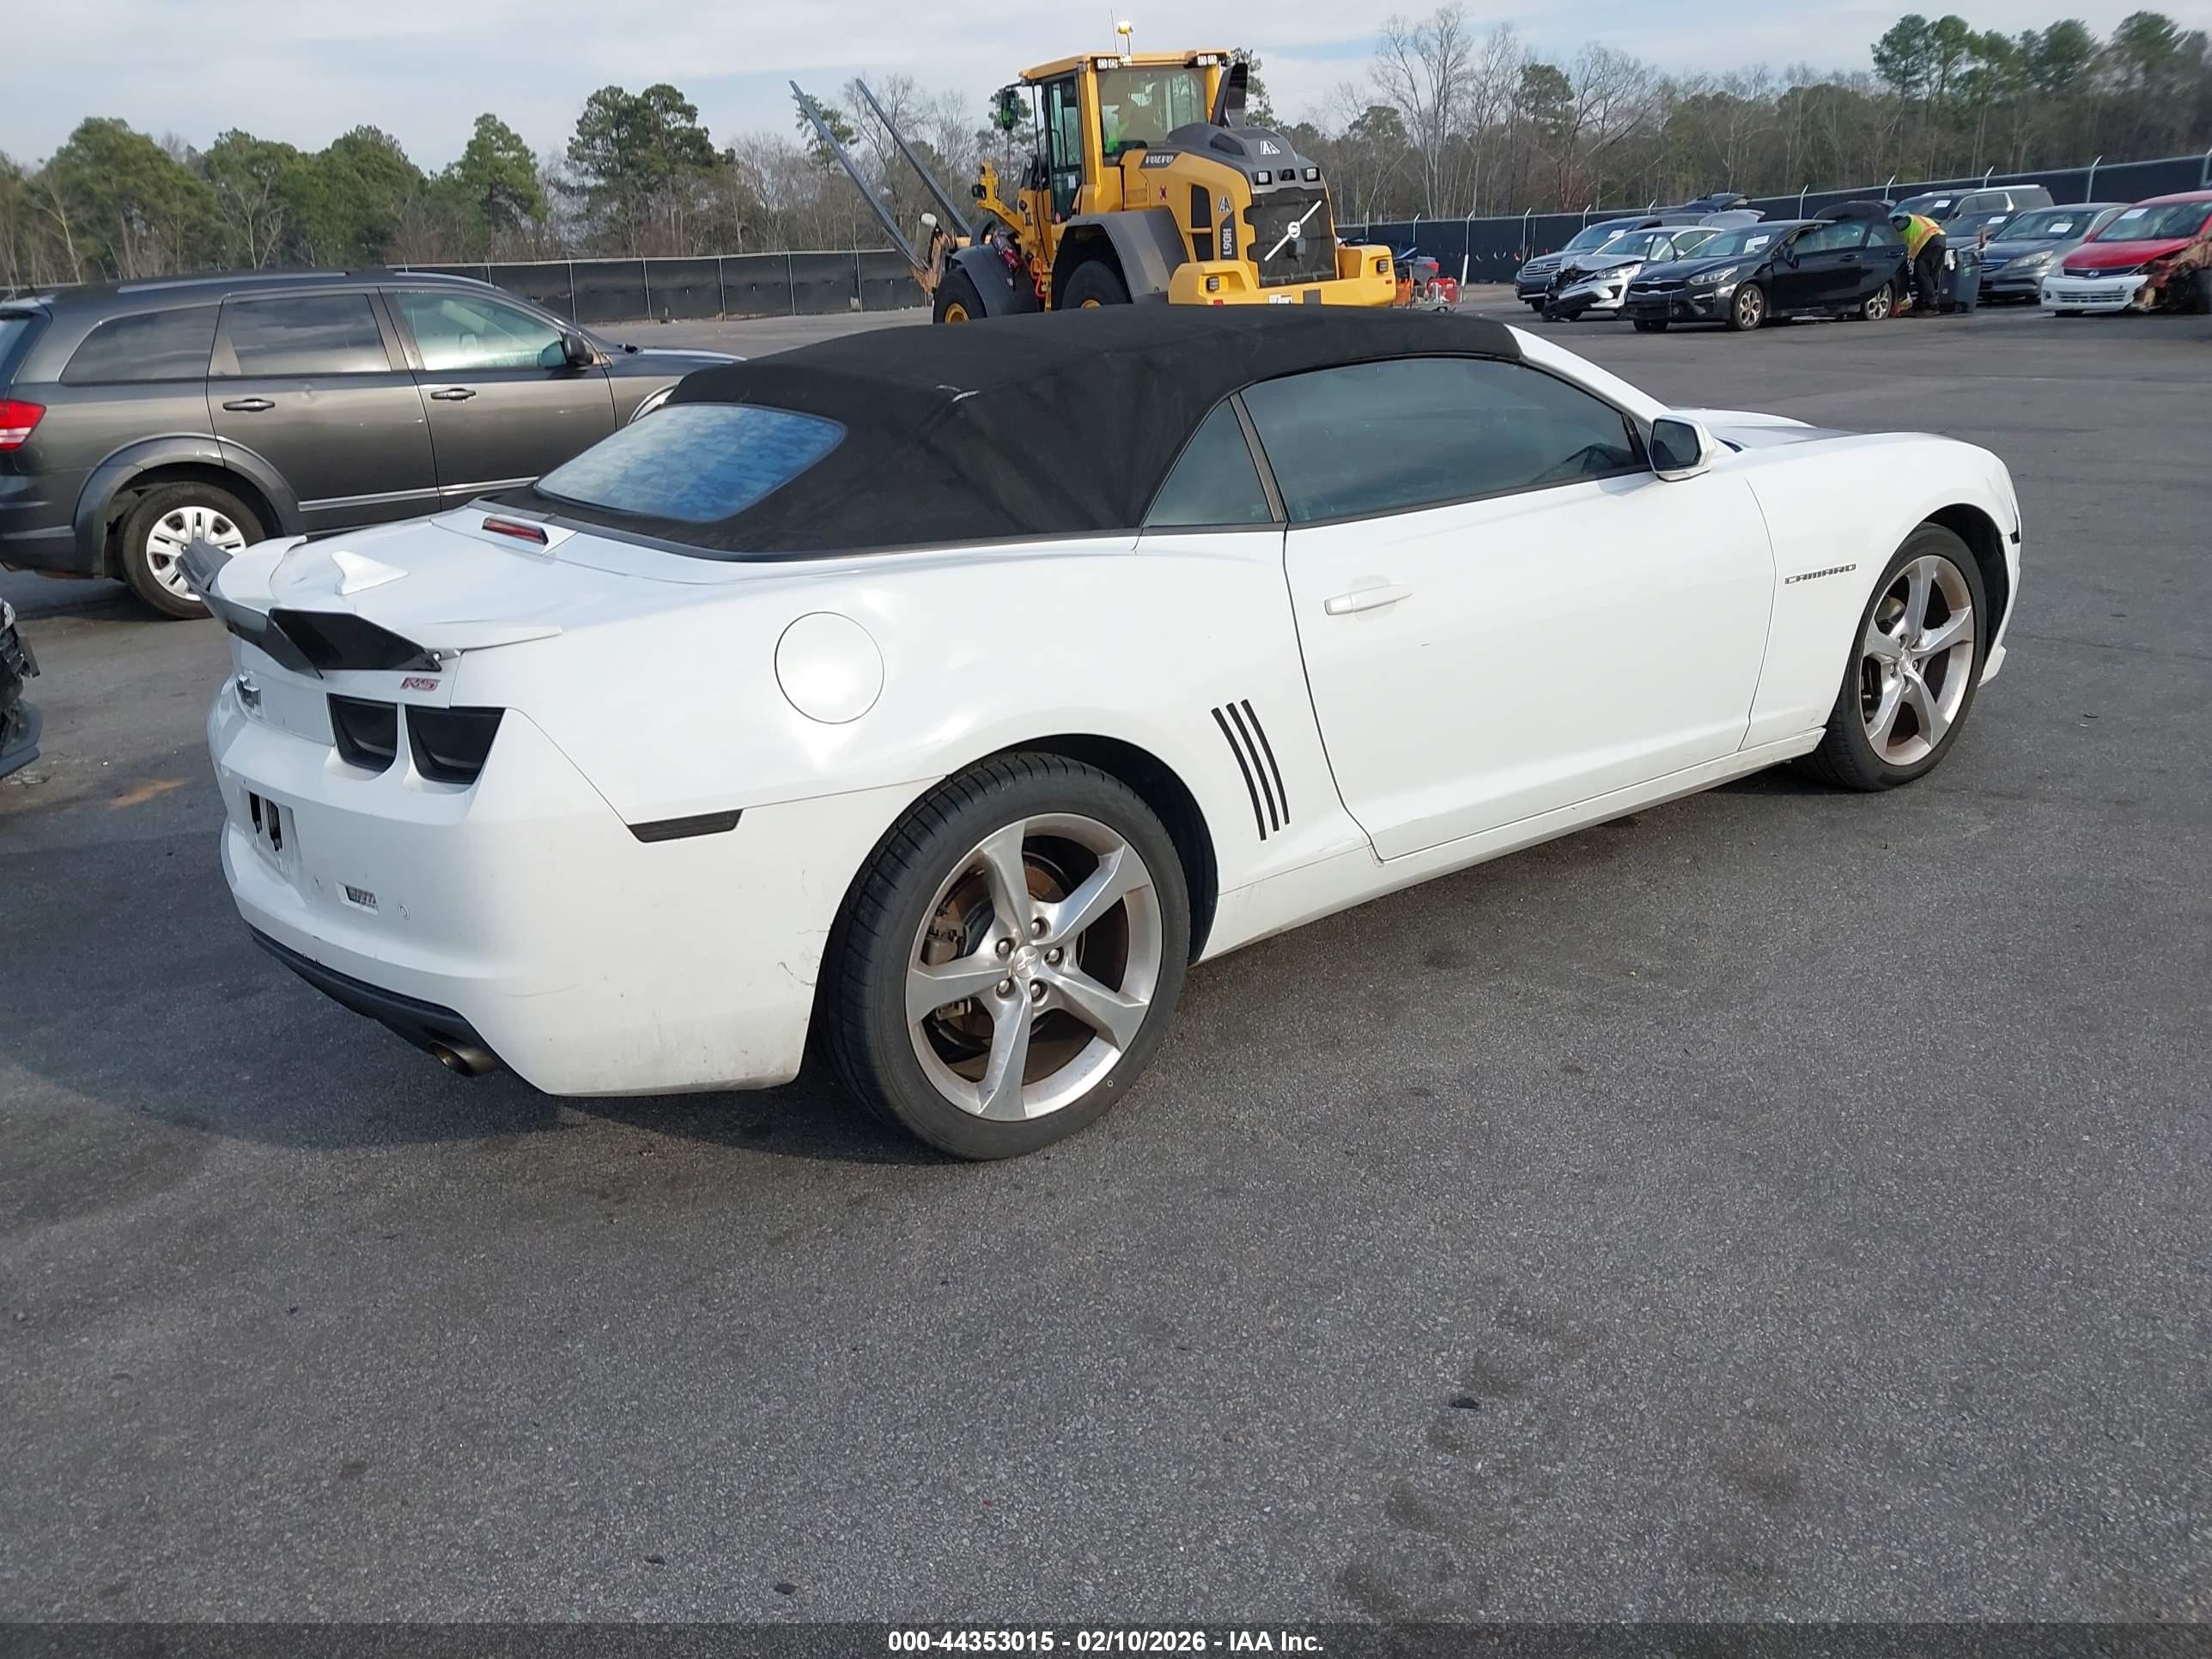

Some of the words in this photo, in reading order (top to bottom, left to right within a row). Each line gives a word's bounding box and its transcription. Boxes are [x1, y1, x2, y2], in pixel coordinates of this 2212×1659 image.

[1146, 155, 1174, 165] VOLVO
[1223, 228, 1232, 255] L90H
[1784, 563, 1856, 584] CAMARO
[400, 677, 440, 691] RS
